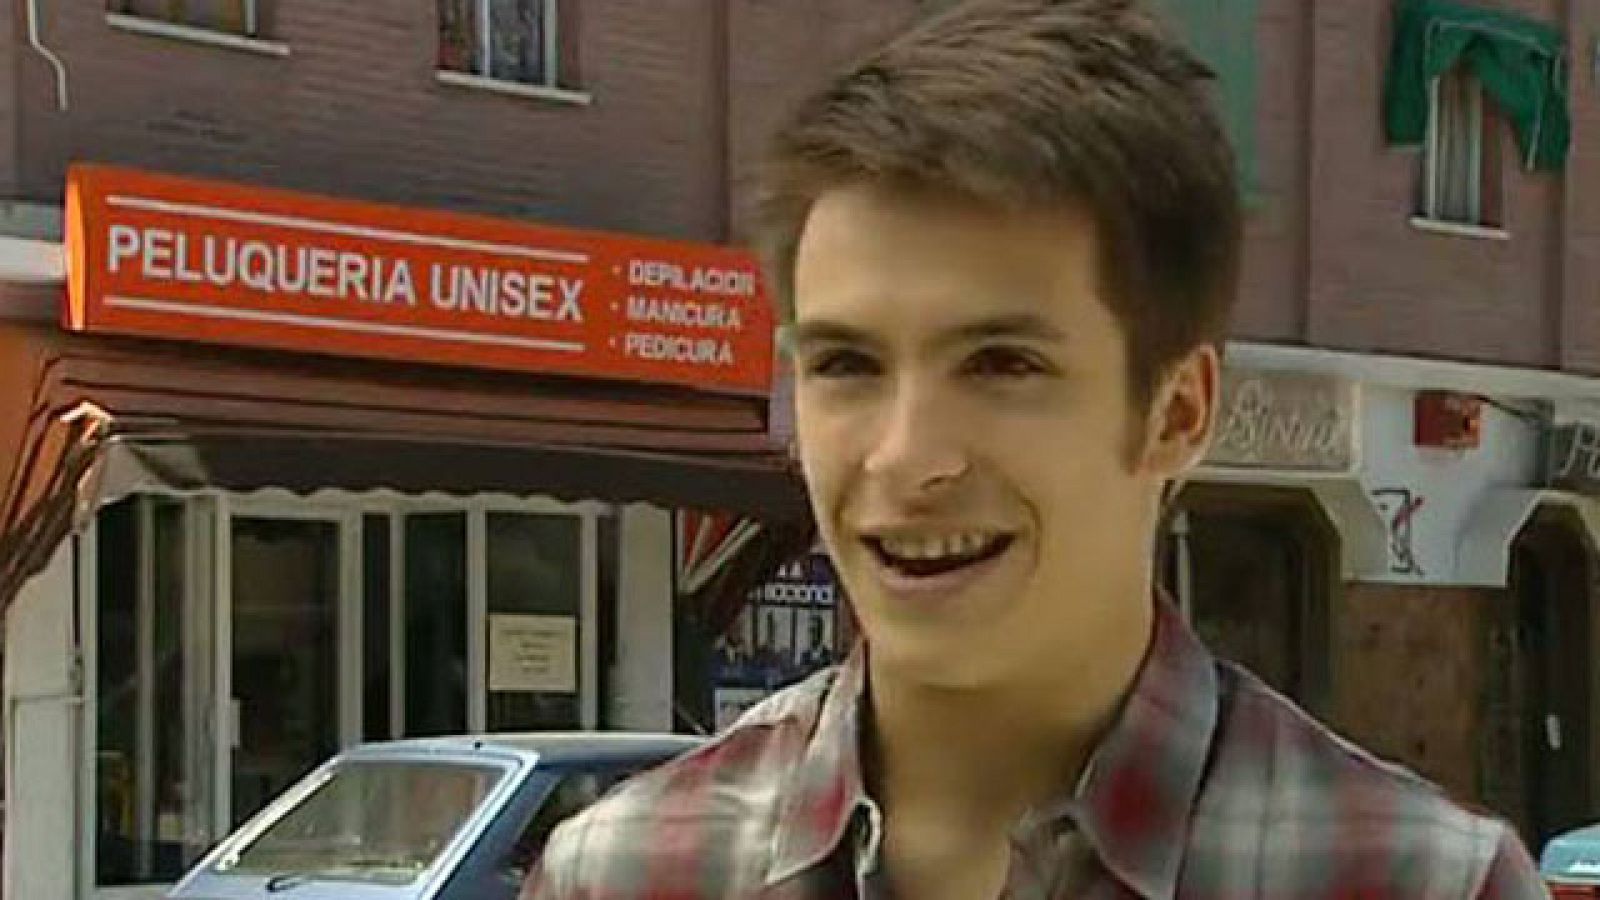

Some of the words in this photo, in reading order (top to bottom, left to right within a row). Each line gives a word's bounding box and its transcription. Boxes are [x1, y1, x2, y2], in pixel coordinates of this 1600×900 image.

[108, 224, 417, 306] PELUQUERIA
[430, 262, 584, 322] UNISEX
[629, 259, 756, 297] DEPILACION
[627, 295, 742, 332] MANICURA
[624, 332, 736, 366] PEDICURA
